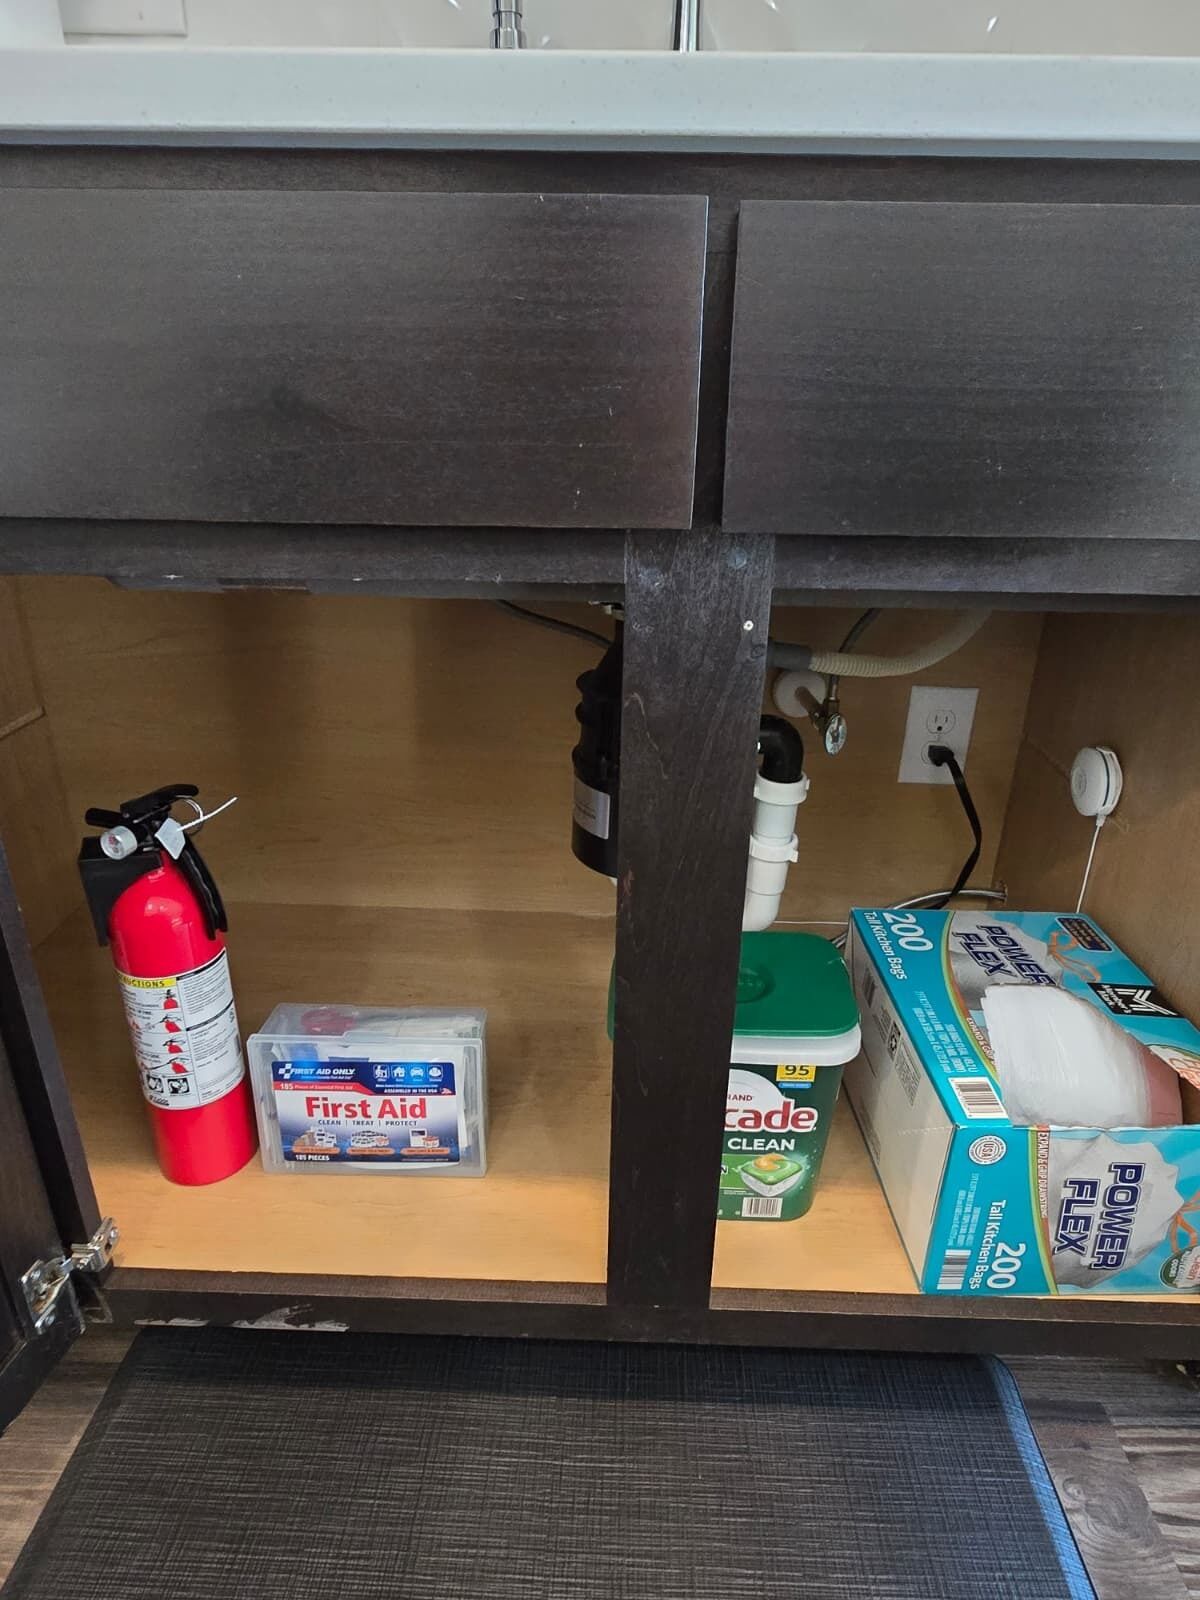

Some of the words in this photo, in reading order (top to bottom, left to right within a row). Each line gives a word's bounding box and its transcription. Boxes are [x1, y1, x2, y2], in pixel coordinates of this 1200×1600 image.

[864, 911, 882, 925] Tall
[882, 912, 934, 951] 200
[870, 924, 895, 956] Kitchen
[887, 957, 908, 980] Bags
[952, 932, 1018, 977] FLEX
[978, 925, 1058, 987] POWER
[785, 1064, 810, 1076] 95
[305, 1096, 371, 1119] First
[377, 1097, 427, 1119] Aid
[725, 1101, 816, 1130] cade
[727, 1137, 796, 1151] CLEAN
[982, 1142, 995, 1158] USA
[1037, 1131, 1049, 1158] EXPAND
[988, 1199, 1007, 1220] Tall
[1052, 1177, 1100, 1257] FLEX
[1090, 1161, 1145, 1270] POWER
[977, 1222, 1001, 1263] Kitchen
[968, 1264, 990, 1290] Bags
[986, 1242, 1027, 1289] 200
